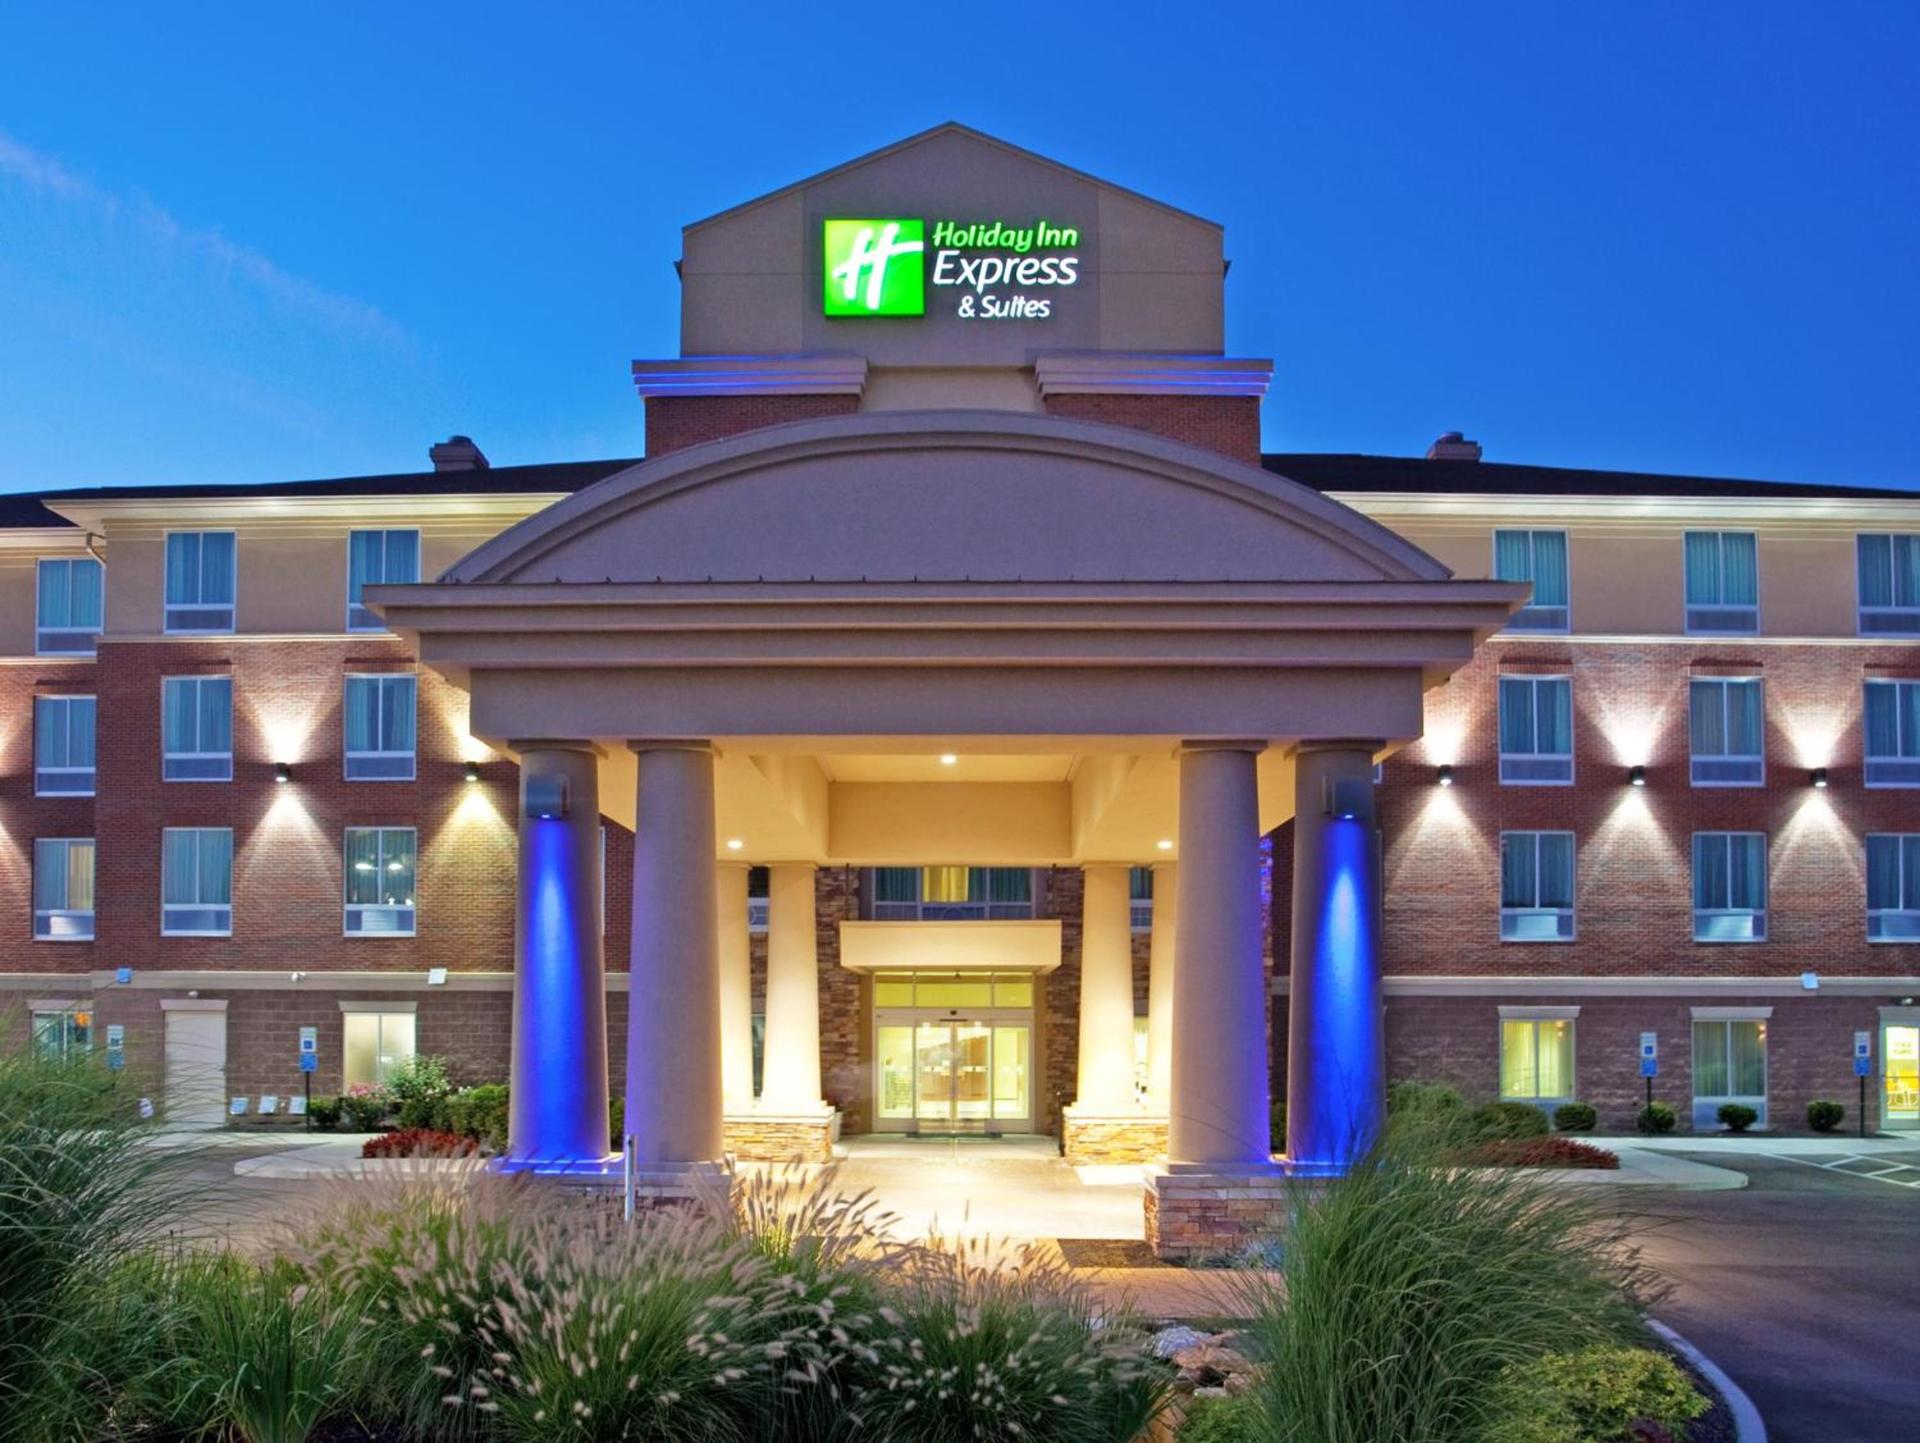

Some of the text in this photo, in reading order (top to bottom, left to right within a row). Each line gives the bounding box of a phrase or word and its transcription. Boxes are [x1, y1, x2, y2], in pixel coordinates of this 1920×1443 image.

[932, 221, 1078, 252] Holiday Inn
[933, 250, 1079, 295] Express
[958, 295, 1051, 318] & Suites
